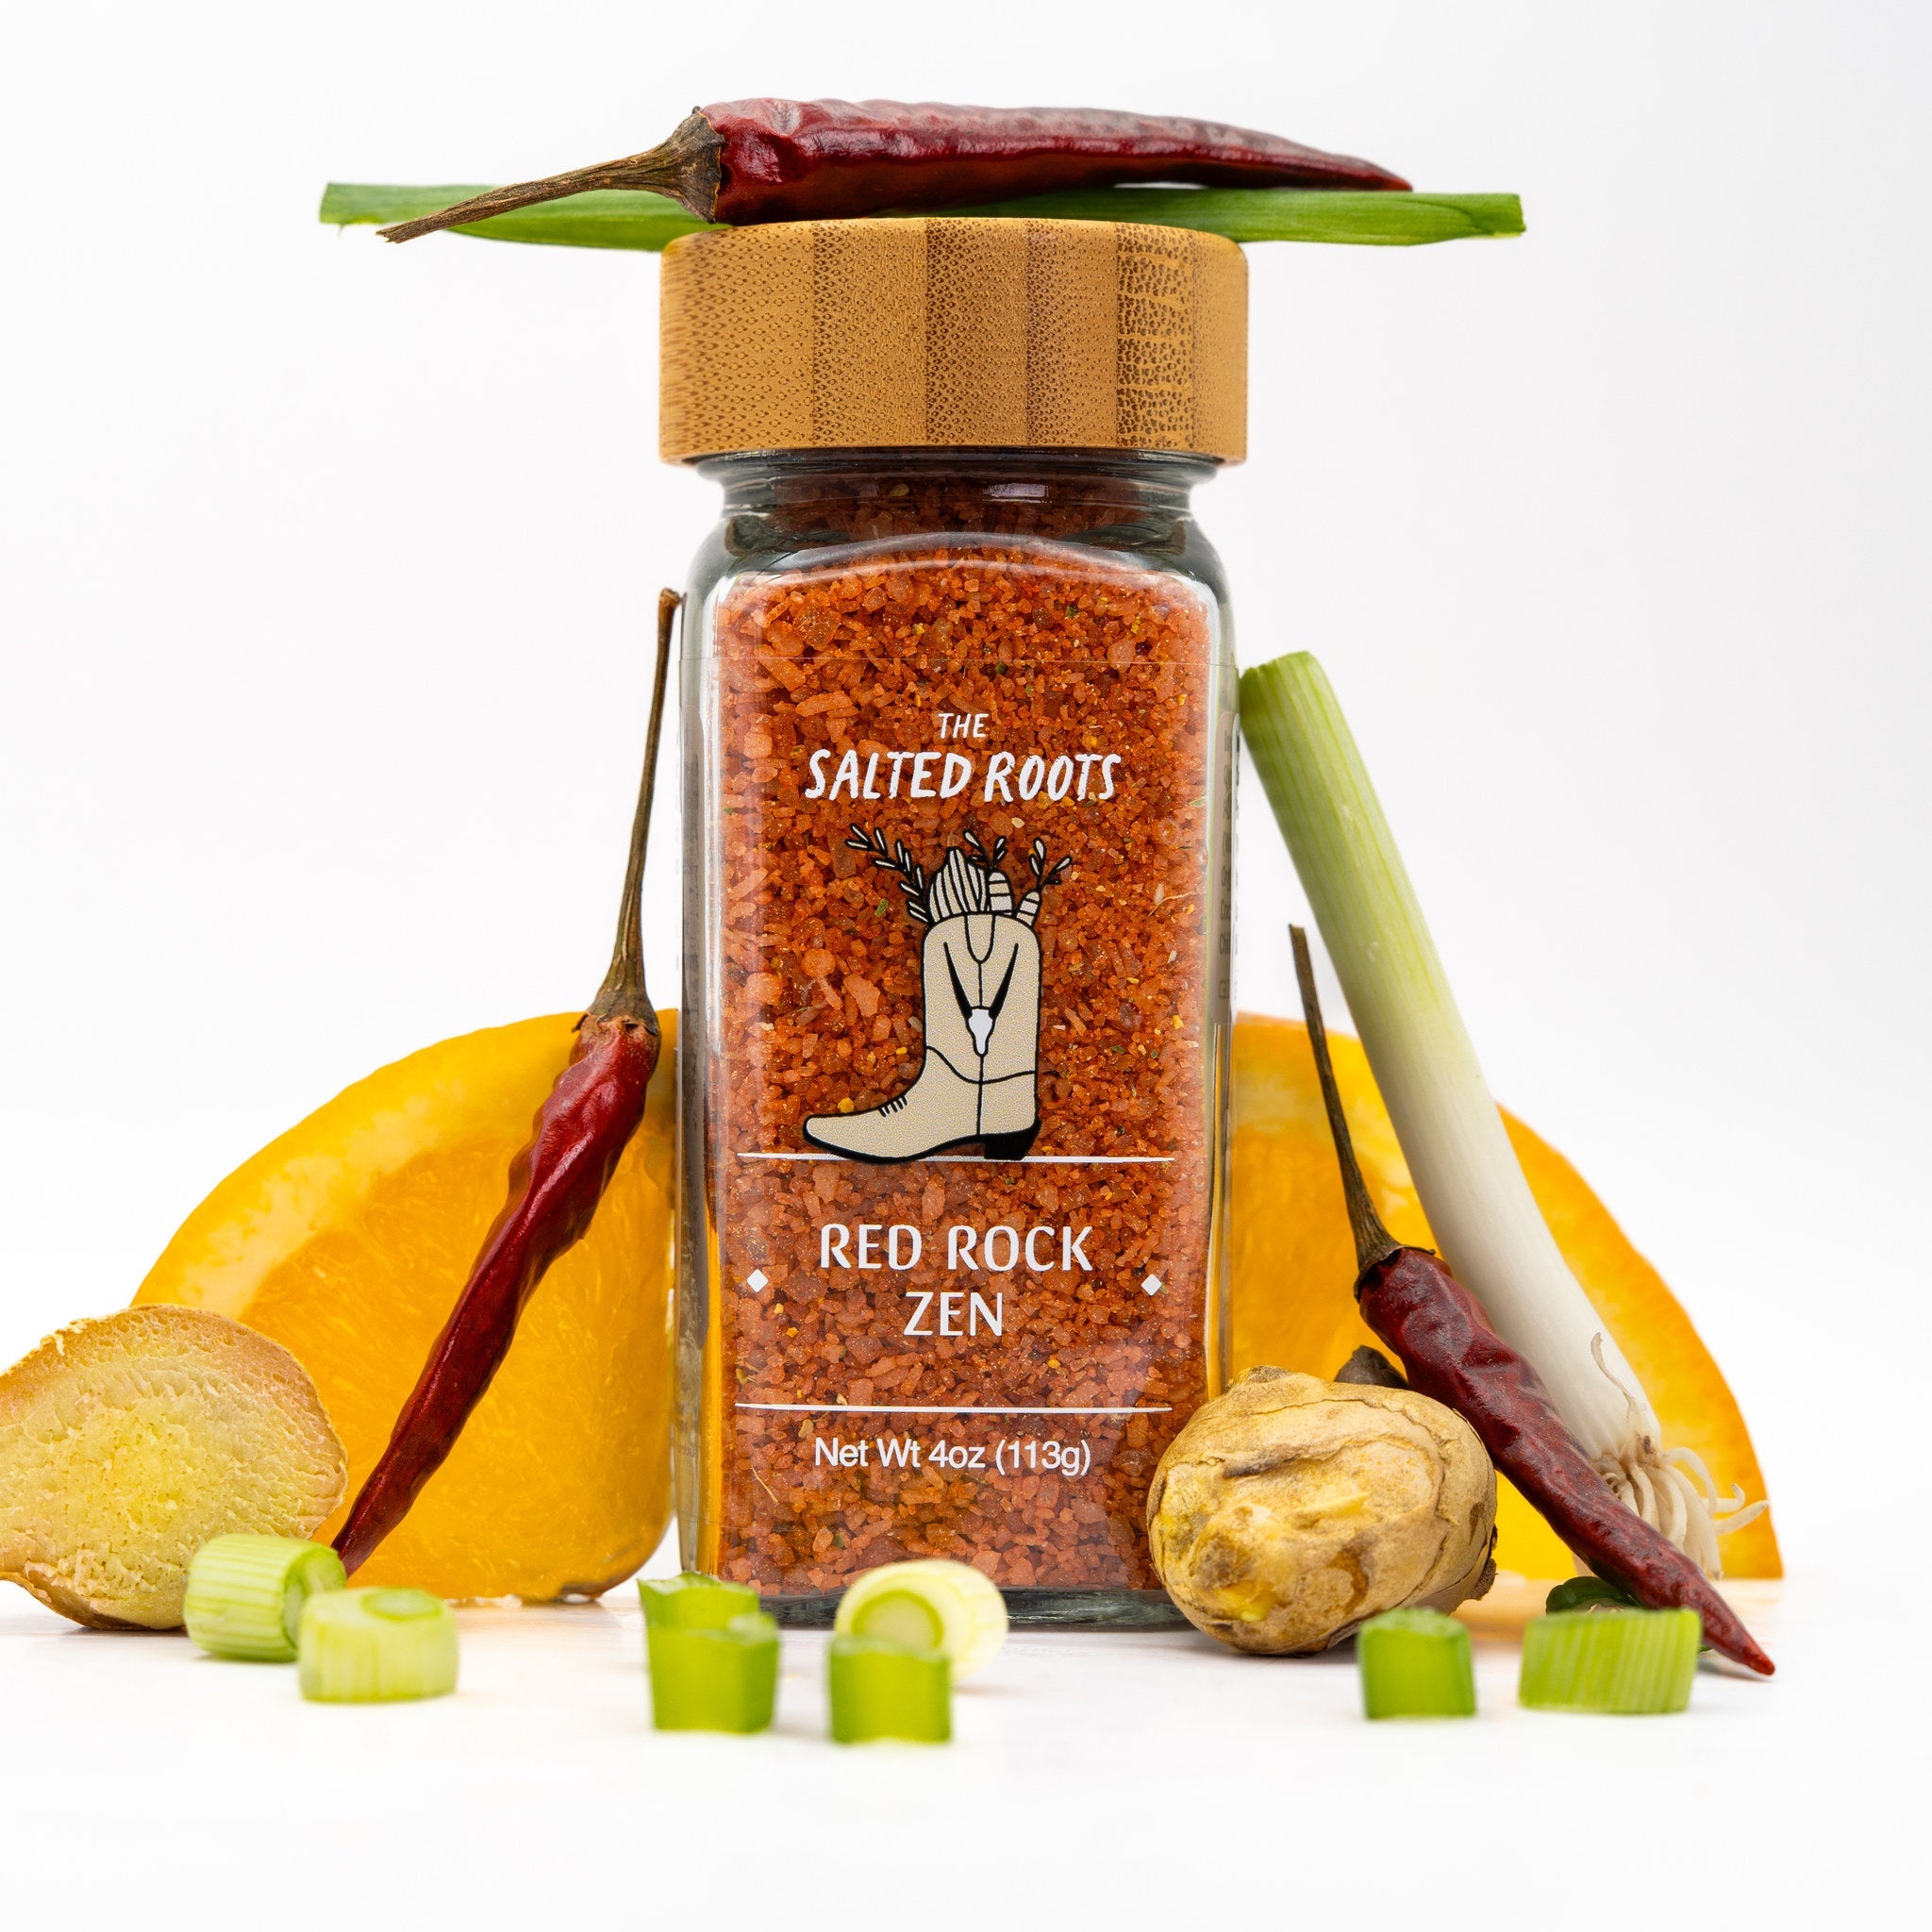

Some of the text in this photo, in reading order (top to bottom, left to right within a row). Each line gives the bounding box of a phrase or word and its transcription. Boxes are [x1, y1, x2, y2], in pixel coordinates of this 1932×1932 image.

[939, 712, 989, 739] THE
[804, 748, 1122, 803] SALTED ROOTS
[820, 1223, 1093, 1272] RED ROCK
[903, 1291, 1003, 1337] ZEN
[815, 1437, 1091, 1476] Net Wt 4oz (113g)
